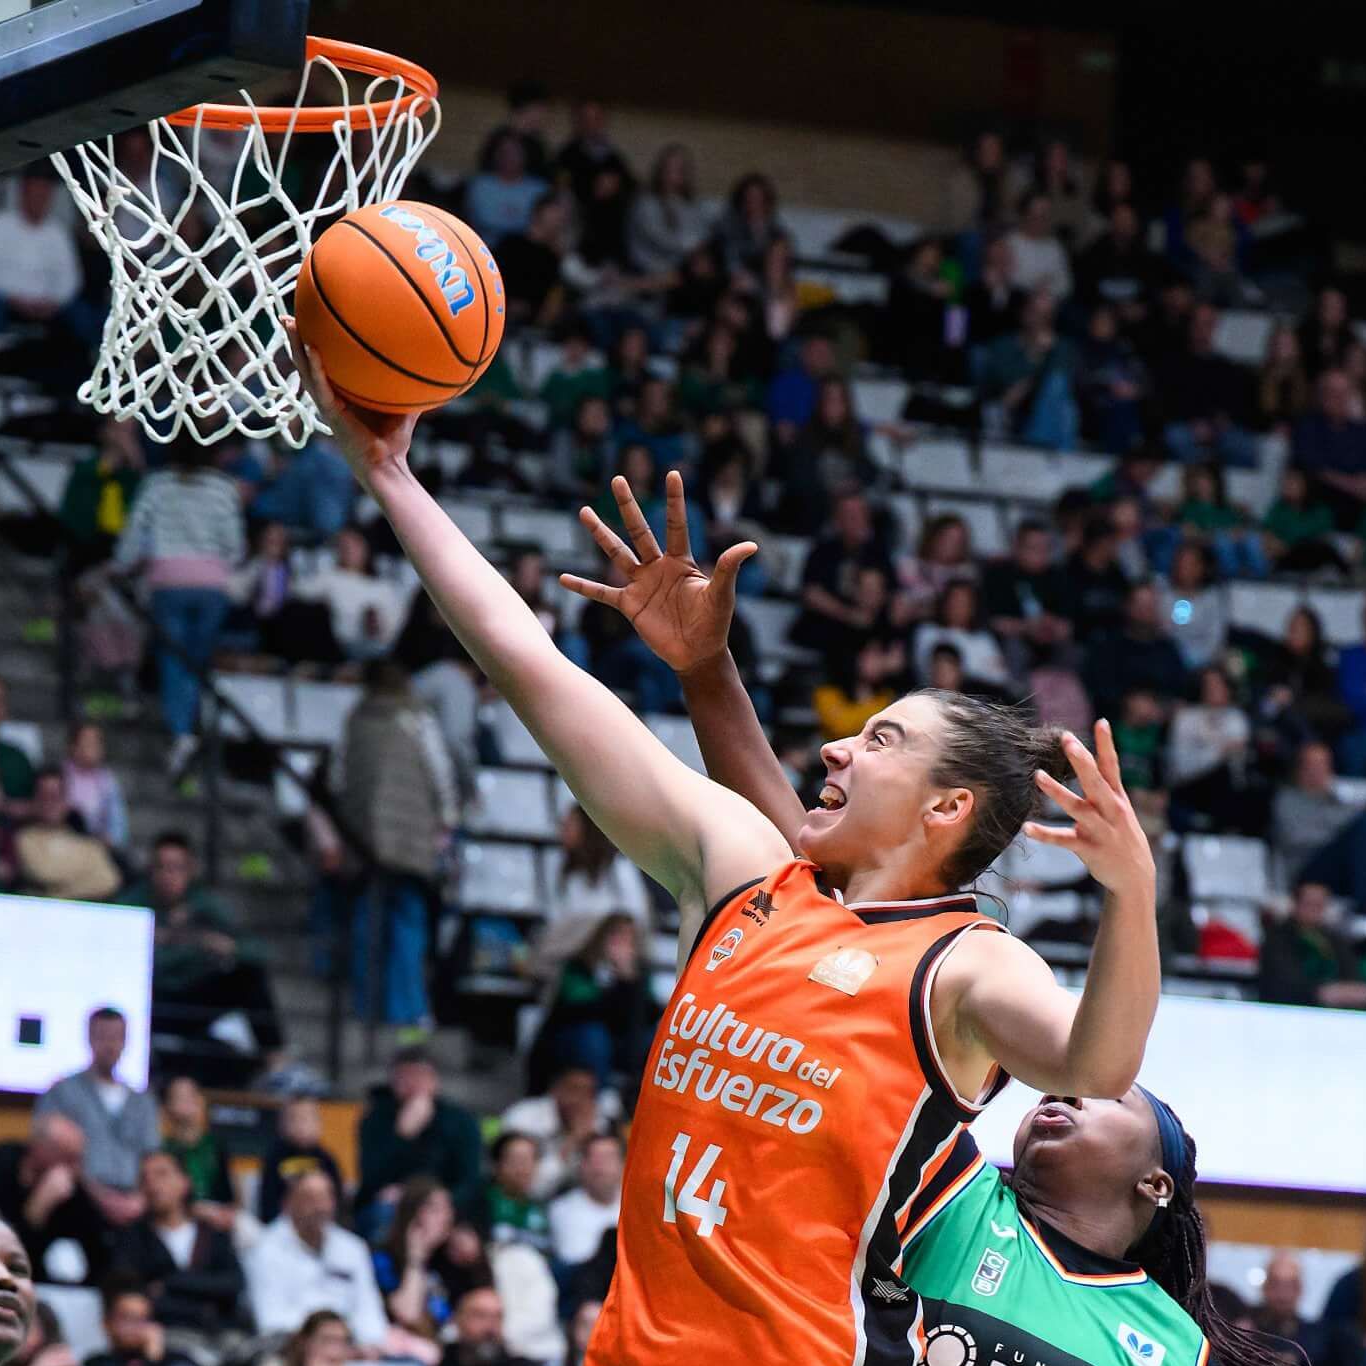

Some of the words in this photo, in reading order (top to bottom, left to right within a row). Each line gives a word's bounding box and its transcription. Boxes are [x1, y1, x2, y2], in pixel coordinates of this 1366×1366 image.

[653, 1039, 824, 1135] Esfuerzo
[669, 992, 805, 1074] Cultura
[797, 1058, 840, 1091] del
[663, 1131, 728, 1238] 14
